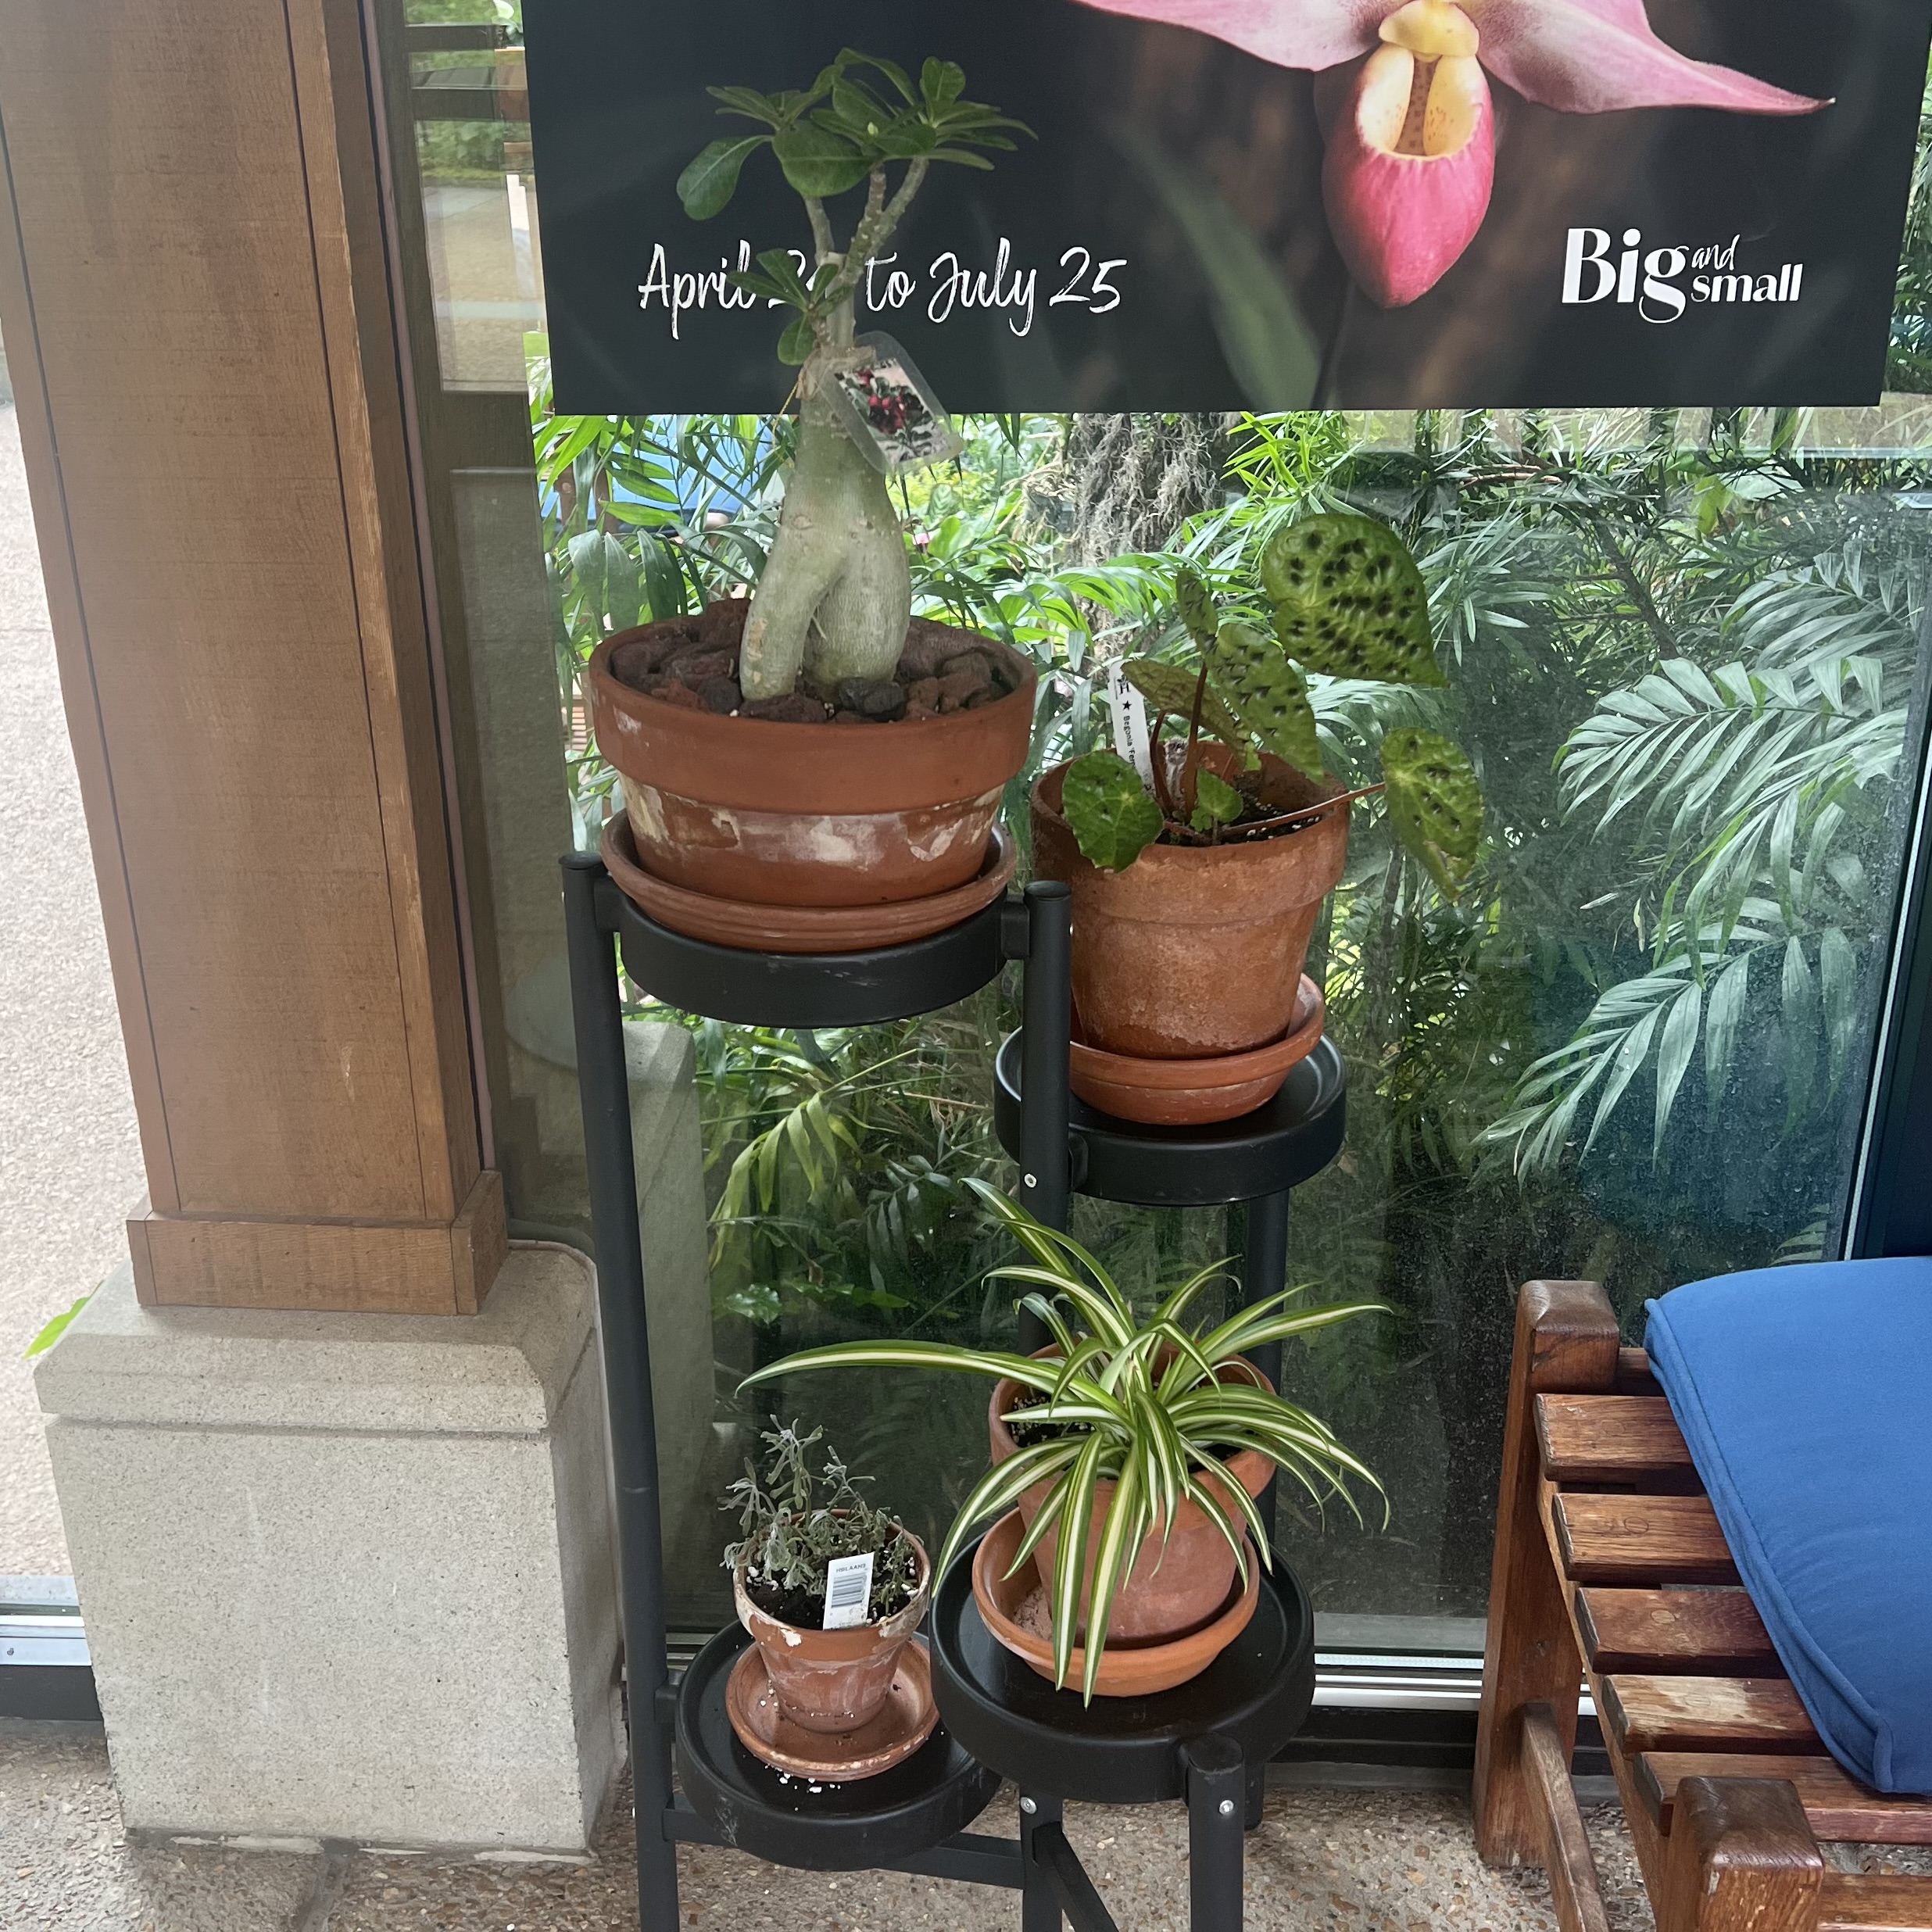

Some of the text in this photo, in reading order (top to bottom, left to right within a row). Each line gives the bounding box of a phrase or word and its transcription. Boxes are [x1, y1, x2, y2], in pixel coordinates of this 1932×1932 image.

[638, 237, 757, 341] April
[864, 252, 918, 312] to
[927, 237, 1038, 337] July
[1048, 246, 1129, 313] 25
[1562, 227, 1741, 324] Big and
[1690, 263, 1804, 303] small
[1123, 715, 1132, 746] Begonia
